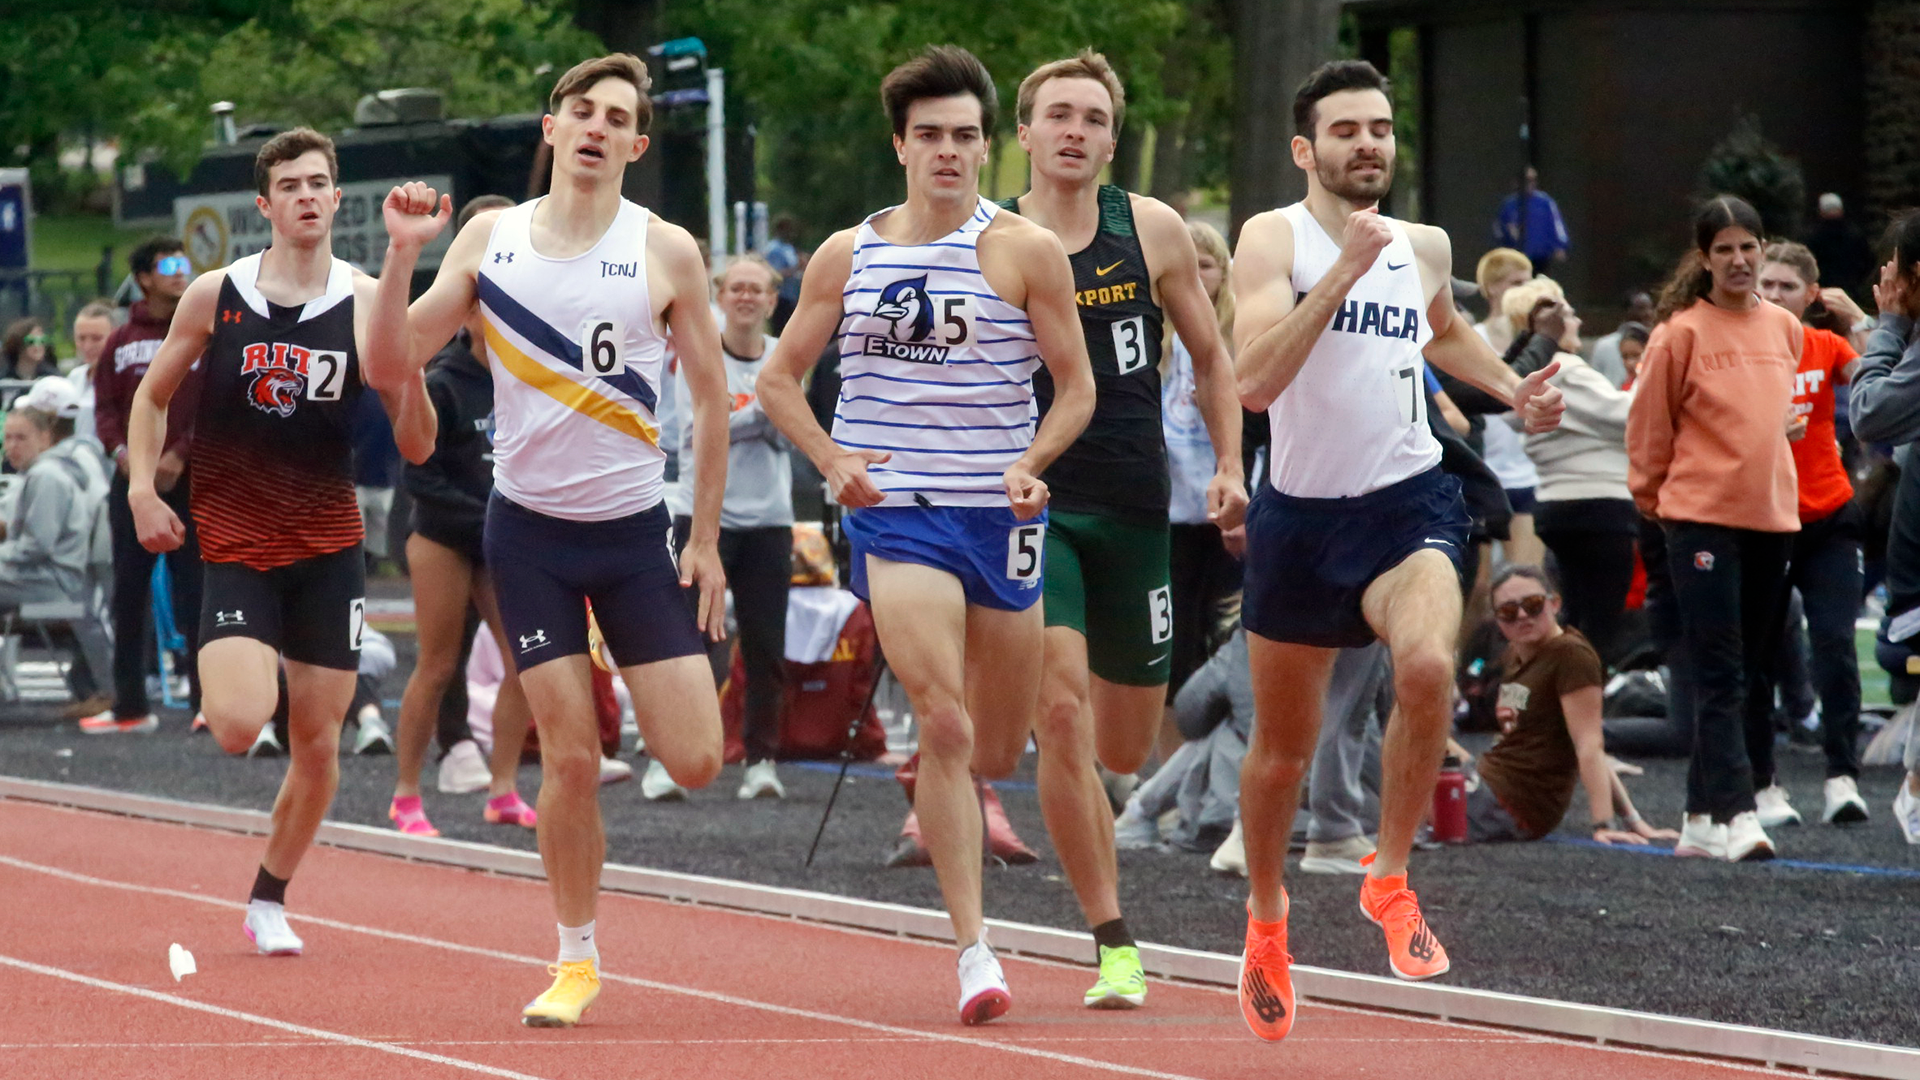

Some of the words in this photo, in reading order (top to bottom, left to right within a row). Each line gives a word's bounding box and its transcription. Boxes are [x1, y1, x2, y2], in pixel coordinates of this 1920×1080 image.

[600, 260, 638, 278] TCNJ
[944, 298, 968, 345] 5
[1328, 297, 1419, 344] HACA
[241, 342, 312, 376] RIT
[590, 322, 617, 373] 6
[1120, 320, 1141, 370] 3
[1700, 351, 1737, 372] RIT
[314, 354, 338, 399] 2
[1398, 366, 1418, 424] 7
[1791, 369, 1825, 397] IT
[1016, 527, 1038, 578] 5
[355, 602, 364, 647] 2
[1156, 589, 1171, 639] 3
